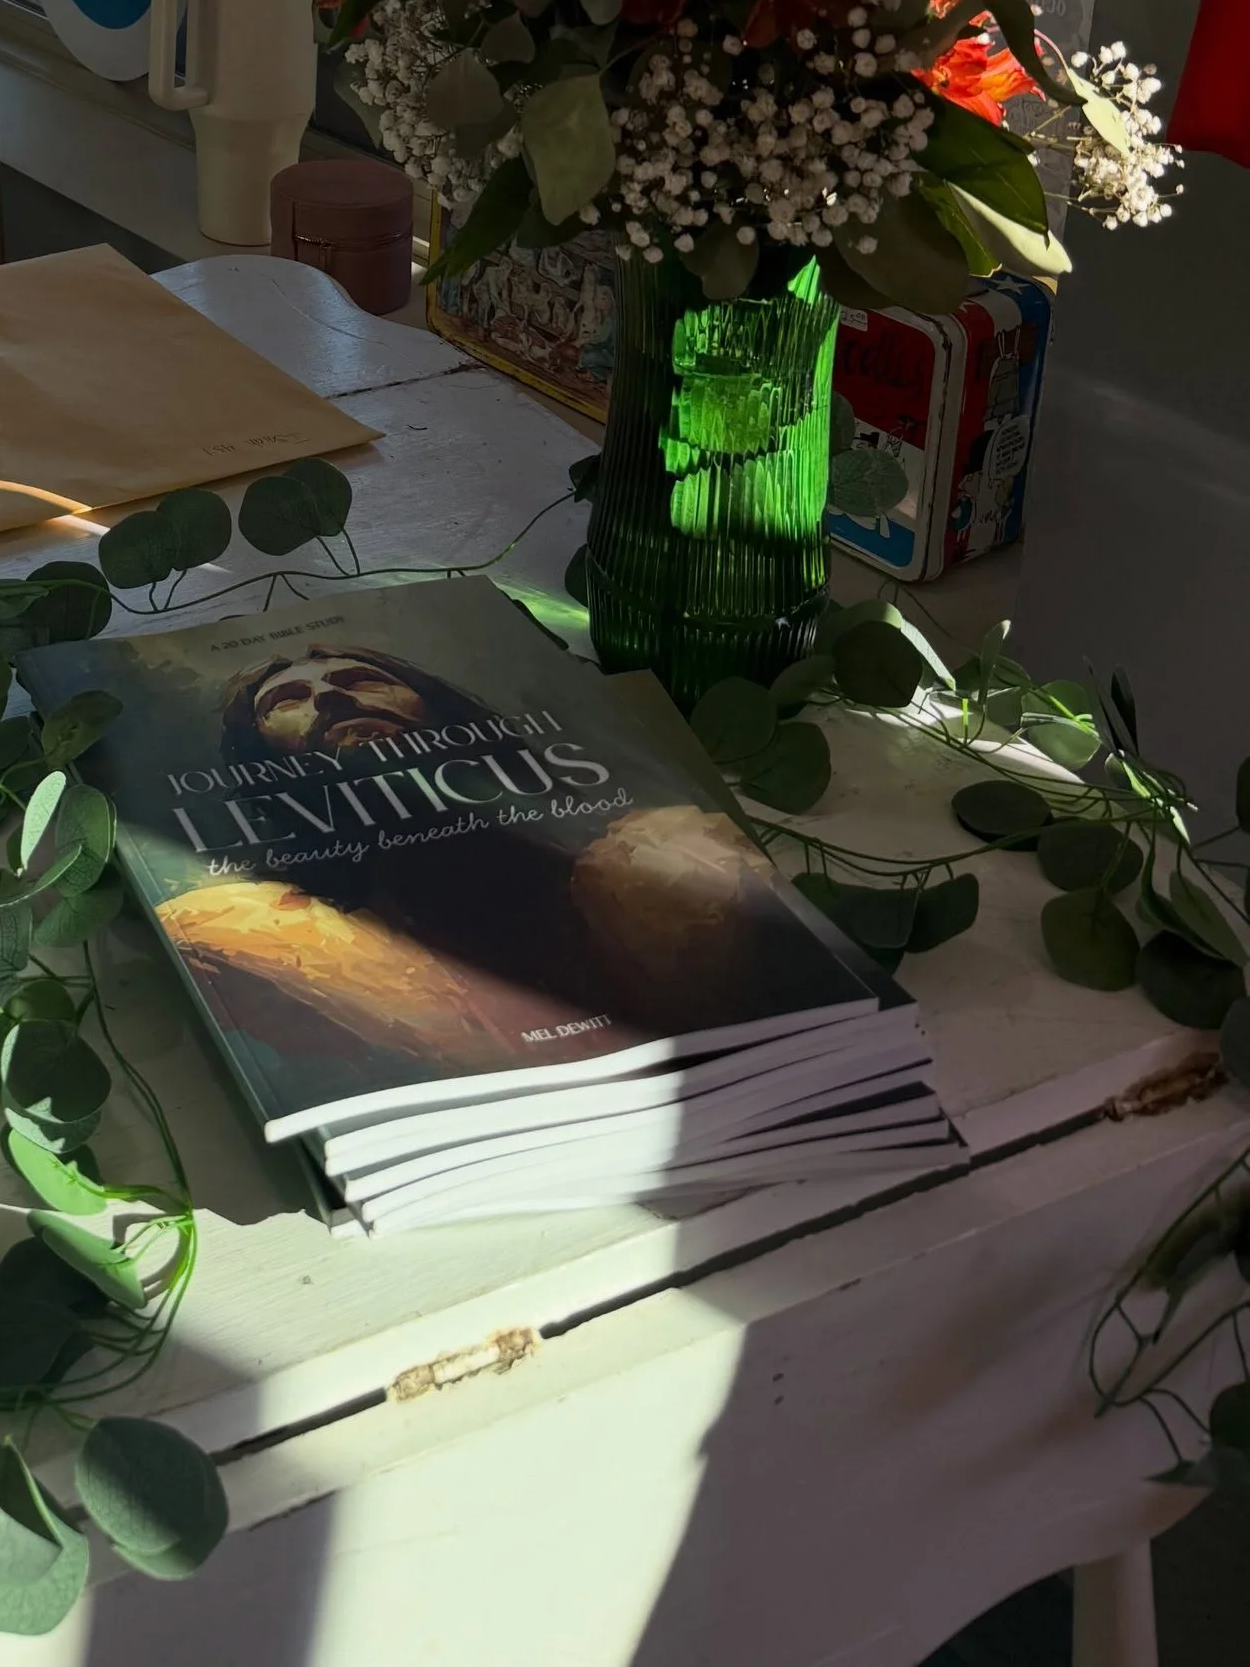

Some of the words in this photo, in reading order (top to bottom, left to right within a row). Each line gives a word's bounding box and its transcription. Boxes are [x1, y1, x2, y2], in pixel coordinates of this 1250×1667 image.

[210, 643, 221, 652] A
[221, 640, 239, 649] 20
[240, 634, 267, 646] DAY
[269, 627, 304, 640] BIBLE
[305, 615, 346, 631] STUDY
[166, 745, 344, 797] JOURNEY
[358, 709, 564, 764] THROUGH
[172, 741, 611, 854] LEVITICUS
[207, 856, 257, 877] the
[265, 837, 370, 870] beauty
[377, 813, 490, 849] beneath
[497, 804, 544, 825] the
[550, 787, 635, 819] blood
[521, 1028, 558, 1043] MEL
[555, 1014, 612, 1038] DEWITT
